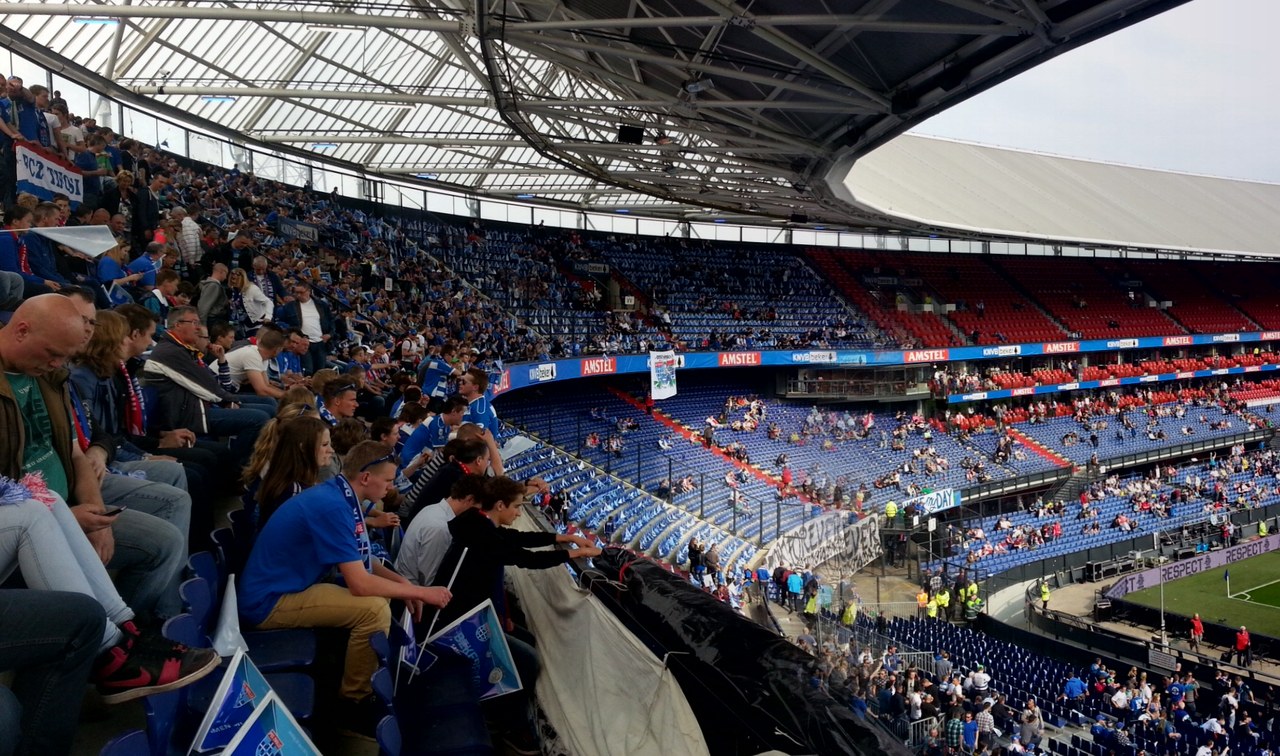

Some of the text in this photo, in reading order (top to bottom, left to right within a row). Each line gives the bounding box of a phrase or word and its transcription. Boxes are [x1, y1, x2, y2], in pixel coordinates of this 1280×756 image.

[1166, 337, 1191, 345] AMSTEL
[1047, 343, 1076, 353] AMSTEL
[722, 353, 757, 365] AMSTEL
[909, 349, 946, 361] AMSTEL
[584, 358, 614, 374] AMSTEL
[1013, 387, 1033, 397] AMSTEL
[936, 489, 953, 509] DAY
[1226, 543, 1264, 564] RESPECT
[1162, 560, 1203, 582] RESPECT
